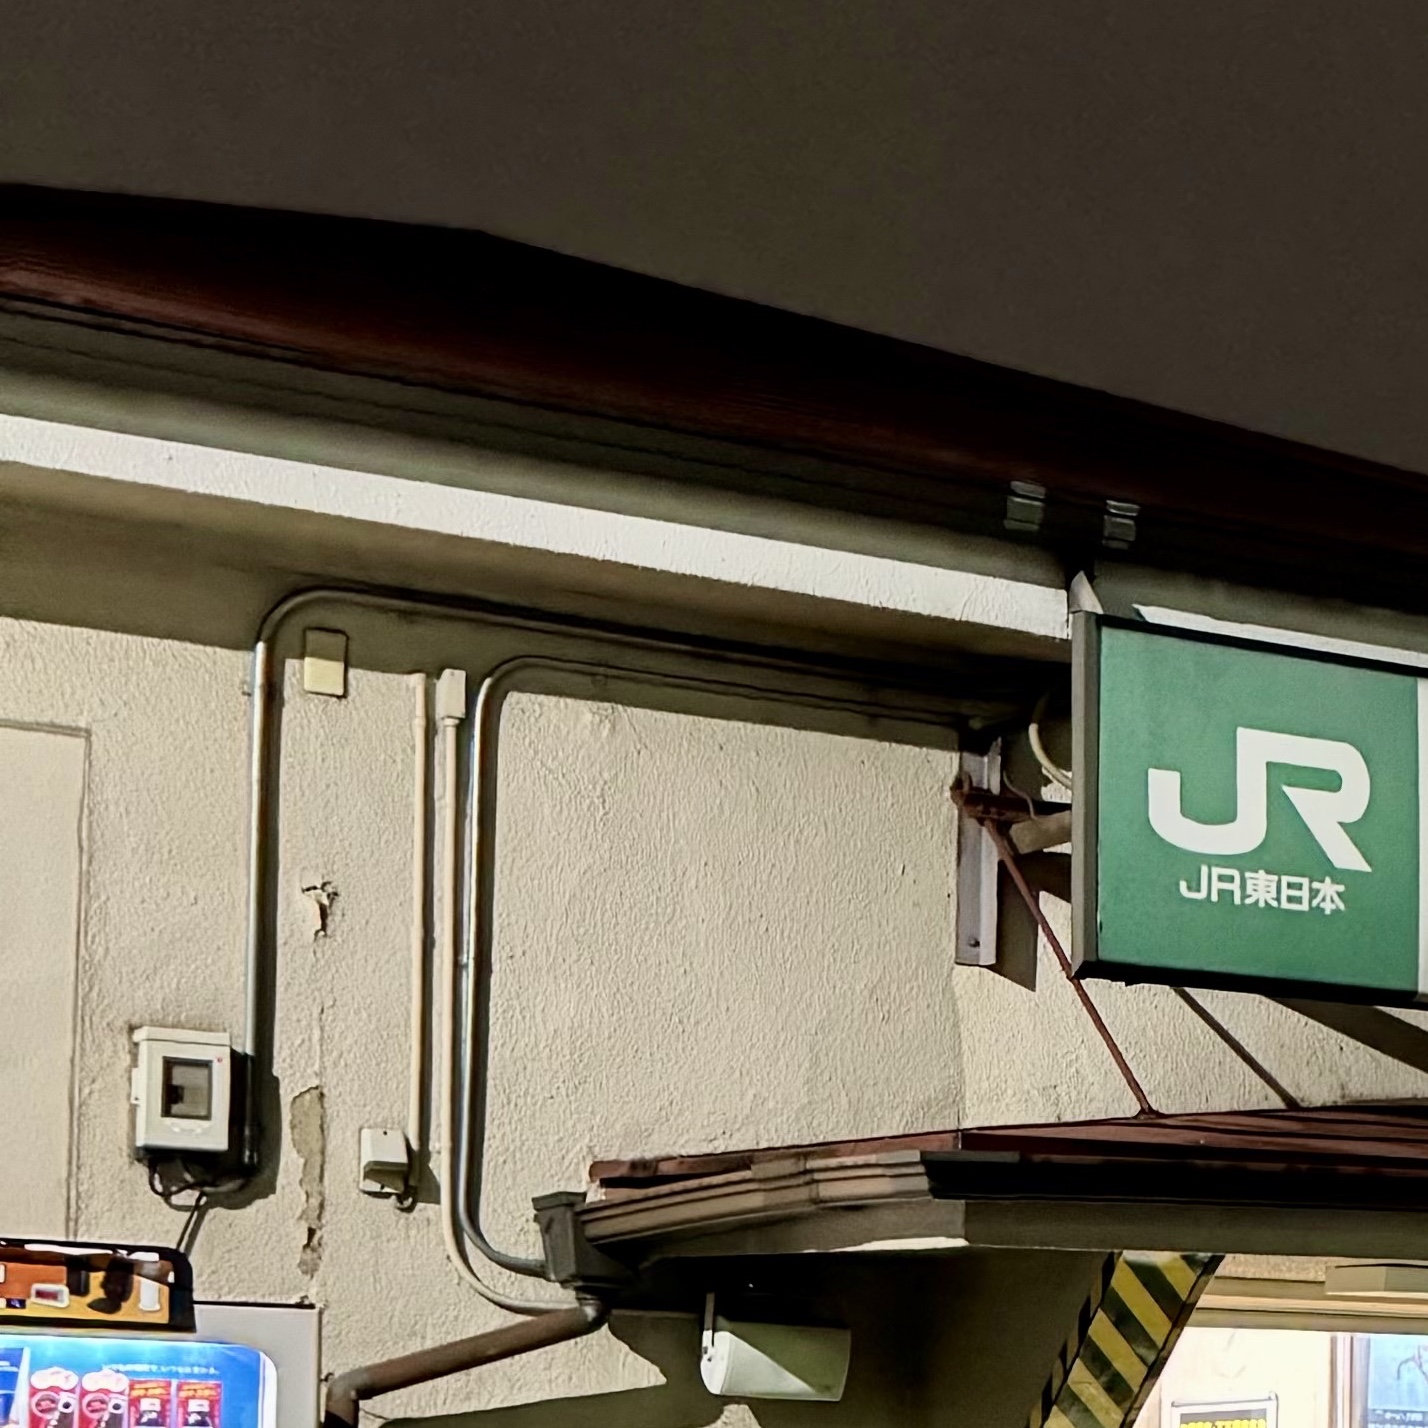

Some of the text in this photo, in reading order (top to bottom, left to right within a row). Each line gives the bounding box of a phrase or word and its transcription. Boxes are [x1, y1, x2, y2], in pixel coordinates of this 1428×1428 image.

[1148, 726, 1372, 873] JR
[1179, 864, 1346, 917] JR東日本
